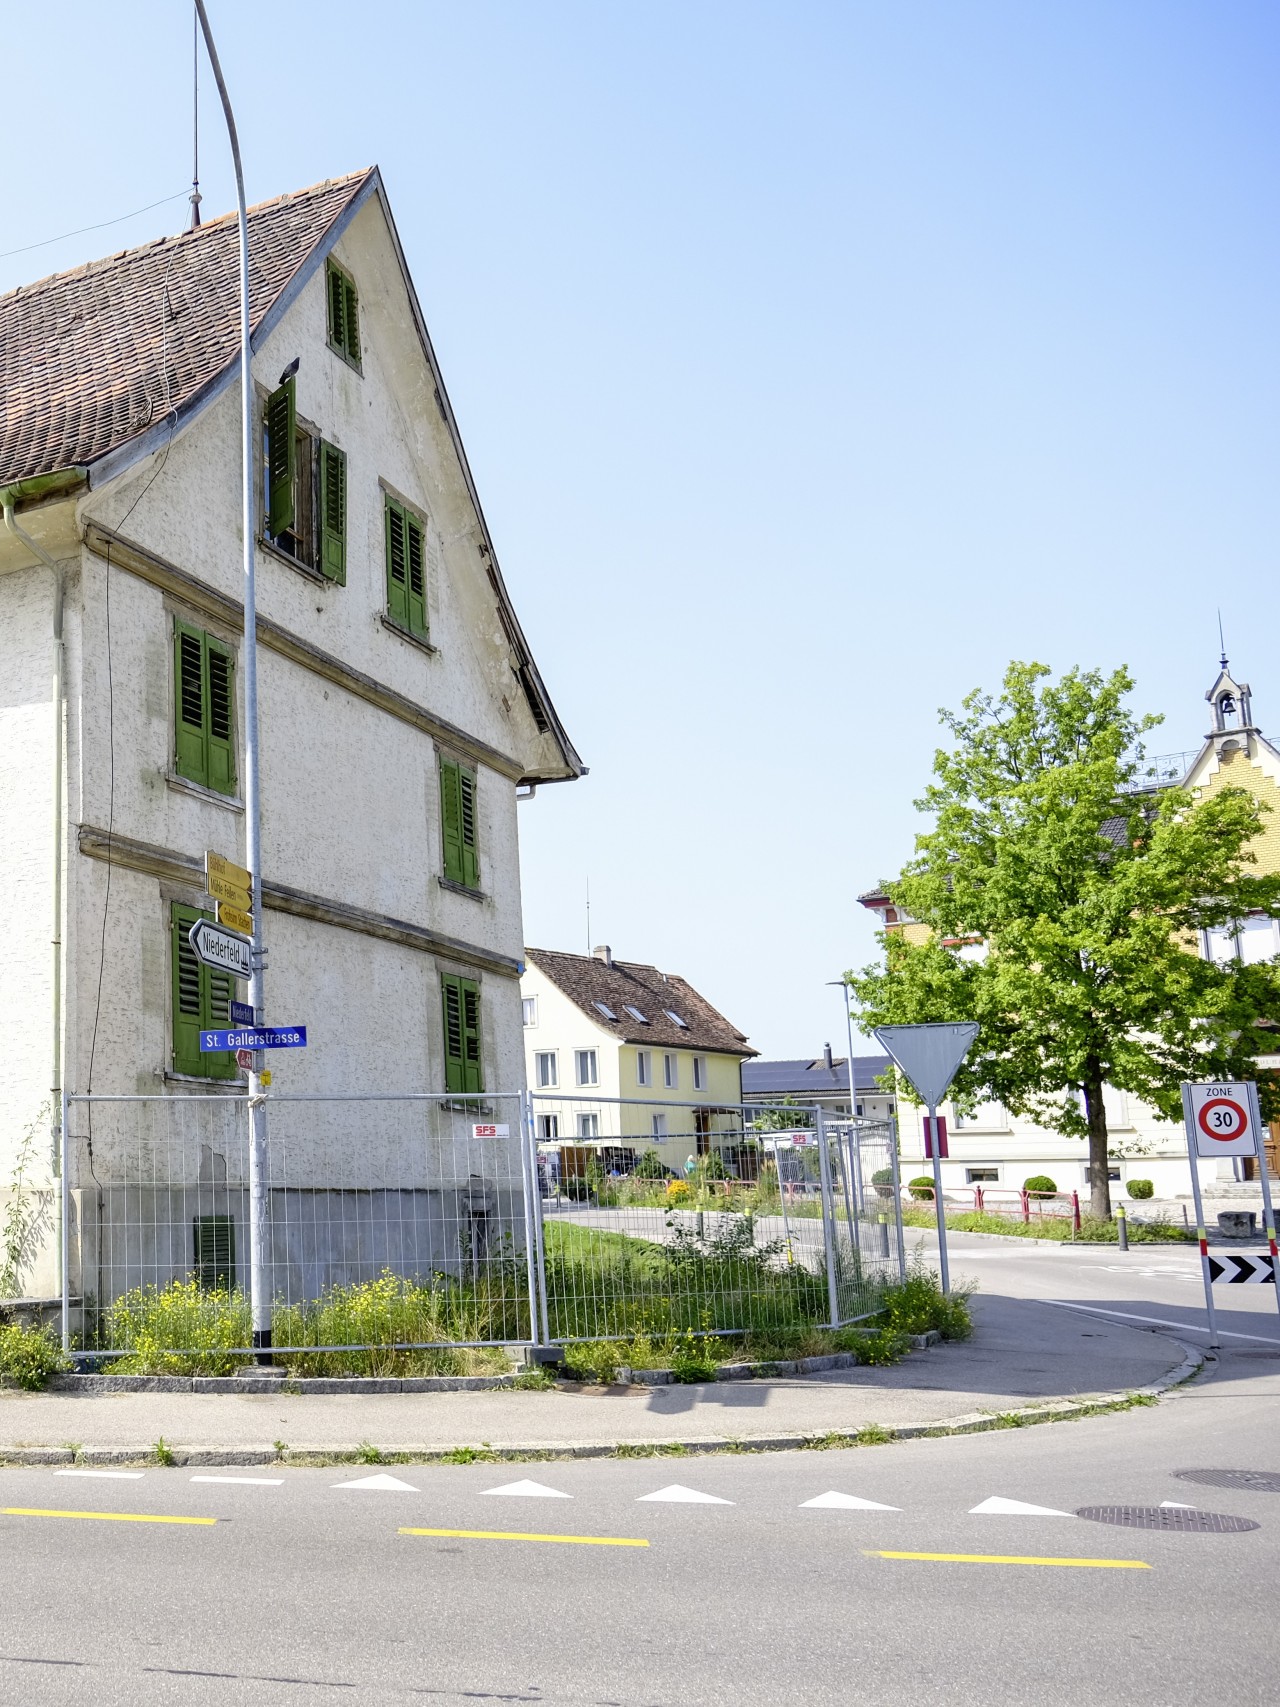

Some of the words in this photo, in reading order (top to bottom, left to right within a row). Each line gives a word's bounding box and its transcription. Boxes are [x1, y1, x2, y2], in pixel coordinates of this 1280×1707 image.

[210, 877, 223, 895] Mühle
[203, 931, 240, 964] Niederfeld
[232, 1004, 252, 1022] Niederfeld
[206, 1034, 221, 1047] St.
[227, 1032, 300, 1046] Gallerstrasse
[1206, 1087, 1233, 1097] ZONE
[1213, 1111, 1233, 1128] 30
[475, 1126, 496, 1134] SFS
[792, 1134, 806, 1142] SFS
